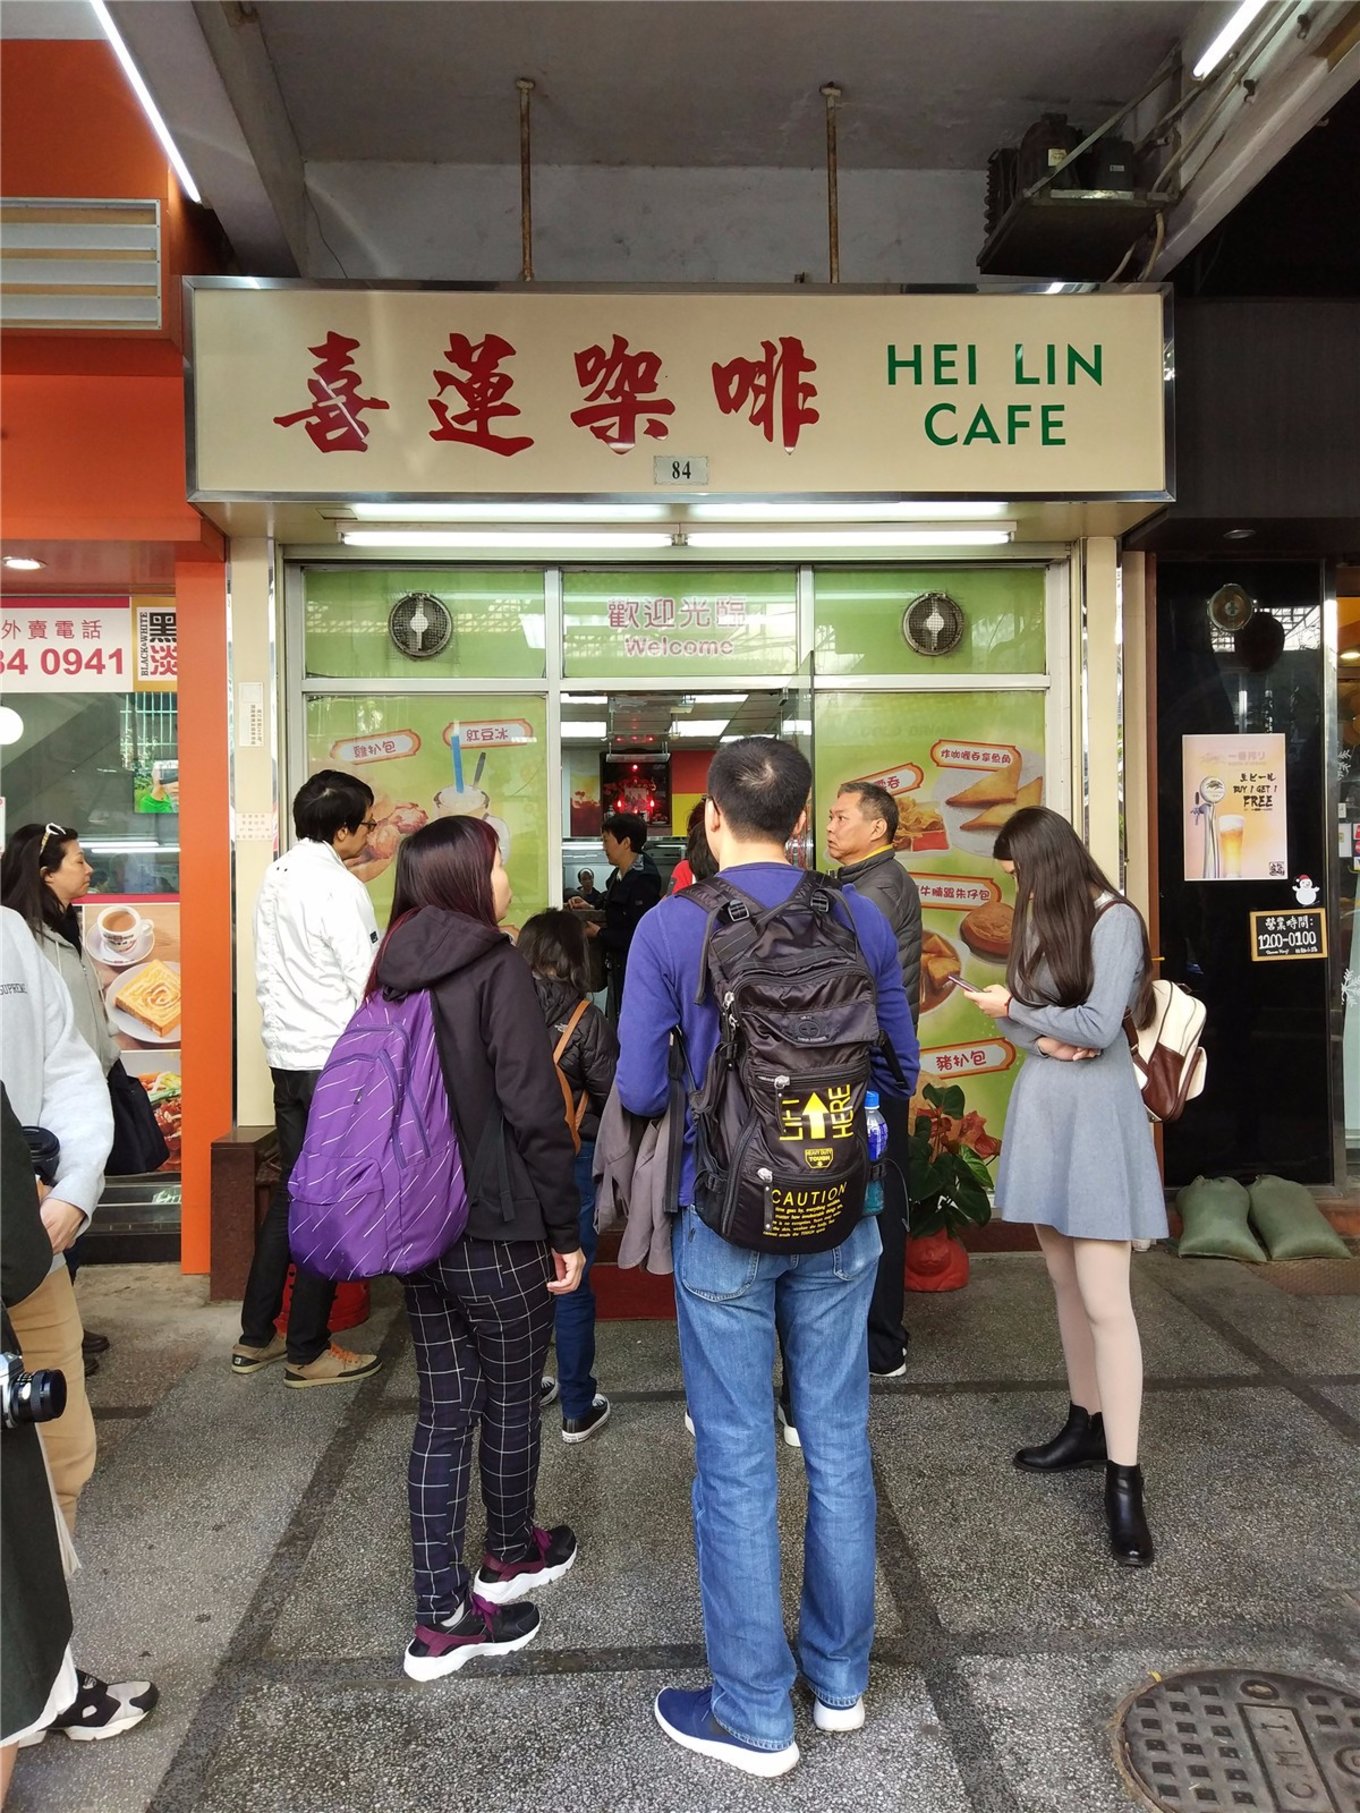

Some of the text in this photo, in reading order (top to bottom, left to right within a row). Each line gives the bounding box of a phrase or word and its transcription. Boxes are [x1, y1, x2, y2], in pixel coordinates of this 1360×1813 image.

[887, 344, 1102, 386] HEI LIN
[924, 403, 1067, 446] CAFE
[672, 461, 691, 479] 84
[608, 597, 746, 628] 歡迎光臨
[1, 619, 102, 640] 外賣電話
[625, 636, 733, 656] Welcome
[41, 648, 123, 675] 0941
[1233, 785, 1248, 793] BUY
[1256, 785, 1271, 793] GET
[1243, 795, 1273, 807] FREE
[936, 1050, 986, 1071] 豬扒包
[828, 1084, 854, 1138] HERE
[772, 1182, 847, 1206] CAUTION
